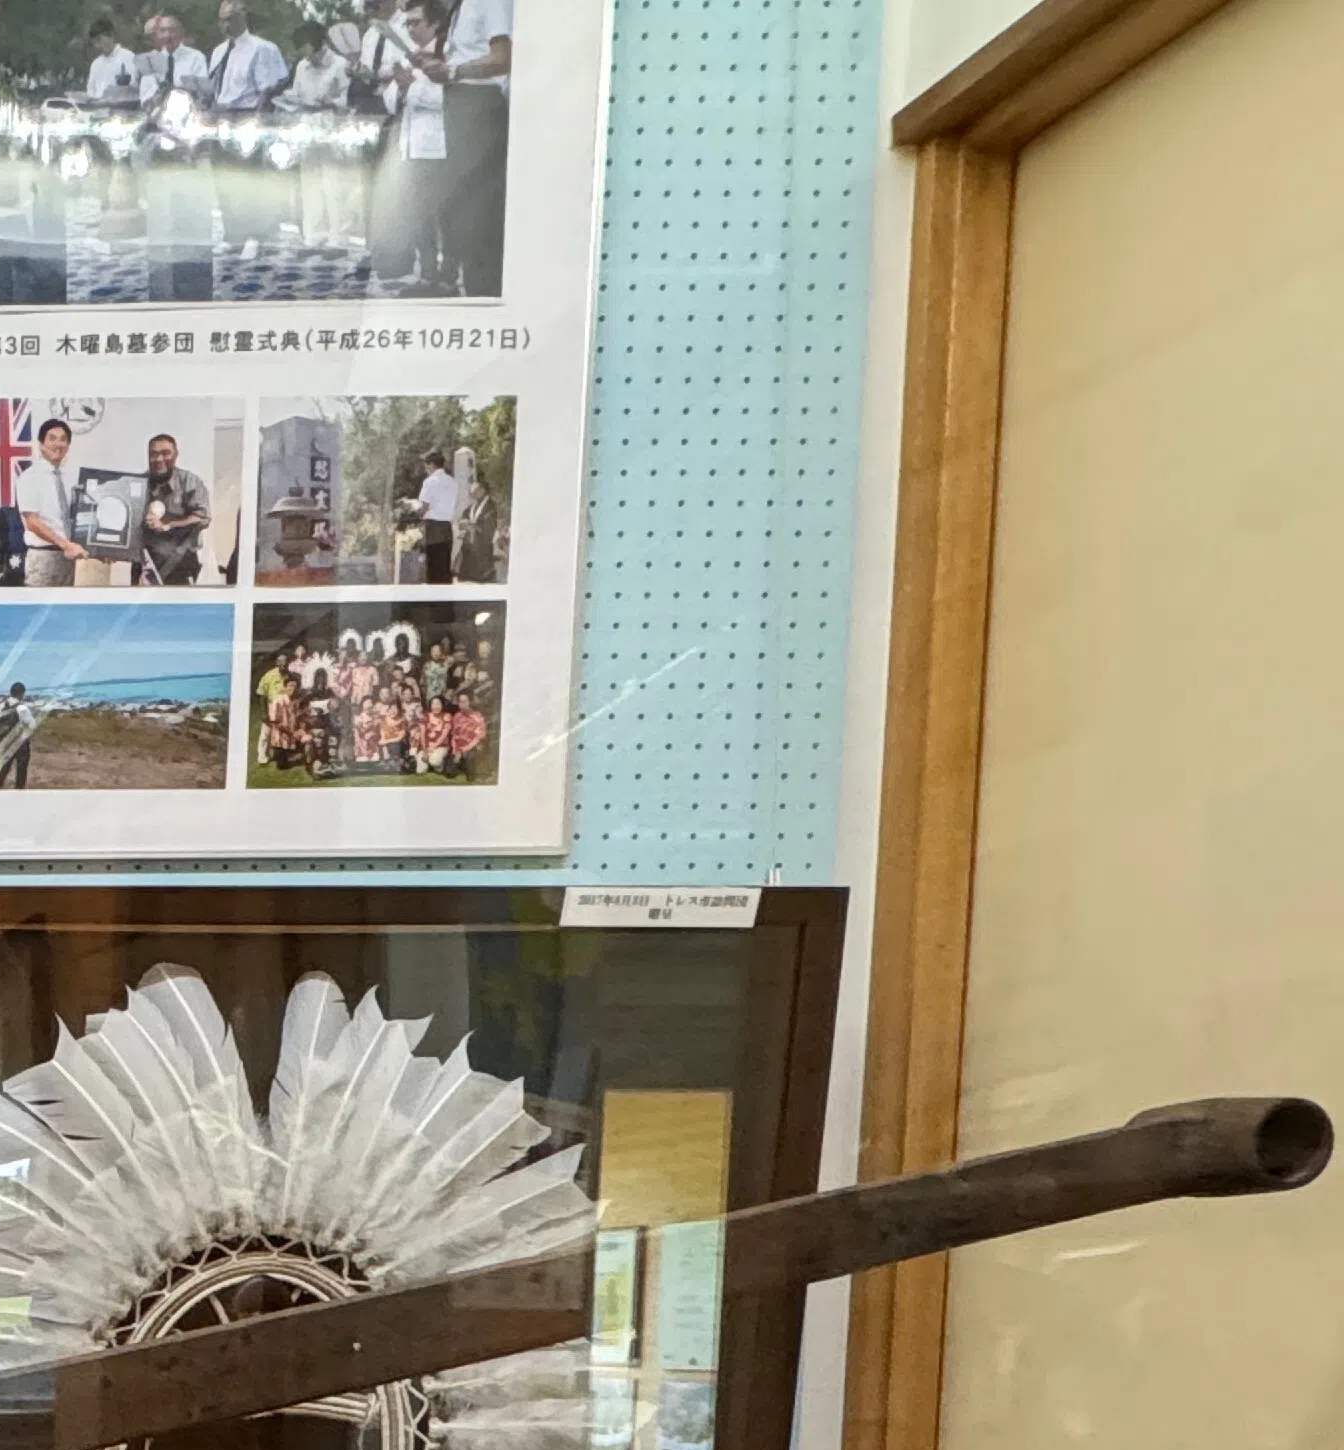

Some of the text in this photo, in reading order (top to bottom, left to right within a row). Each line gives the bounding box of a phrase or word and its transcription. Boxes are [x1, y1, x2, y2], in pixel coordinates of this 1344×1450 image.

[55, 331, 195, 356] 木曜島墓参団
